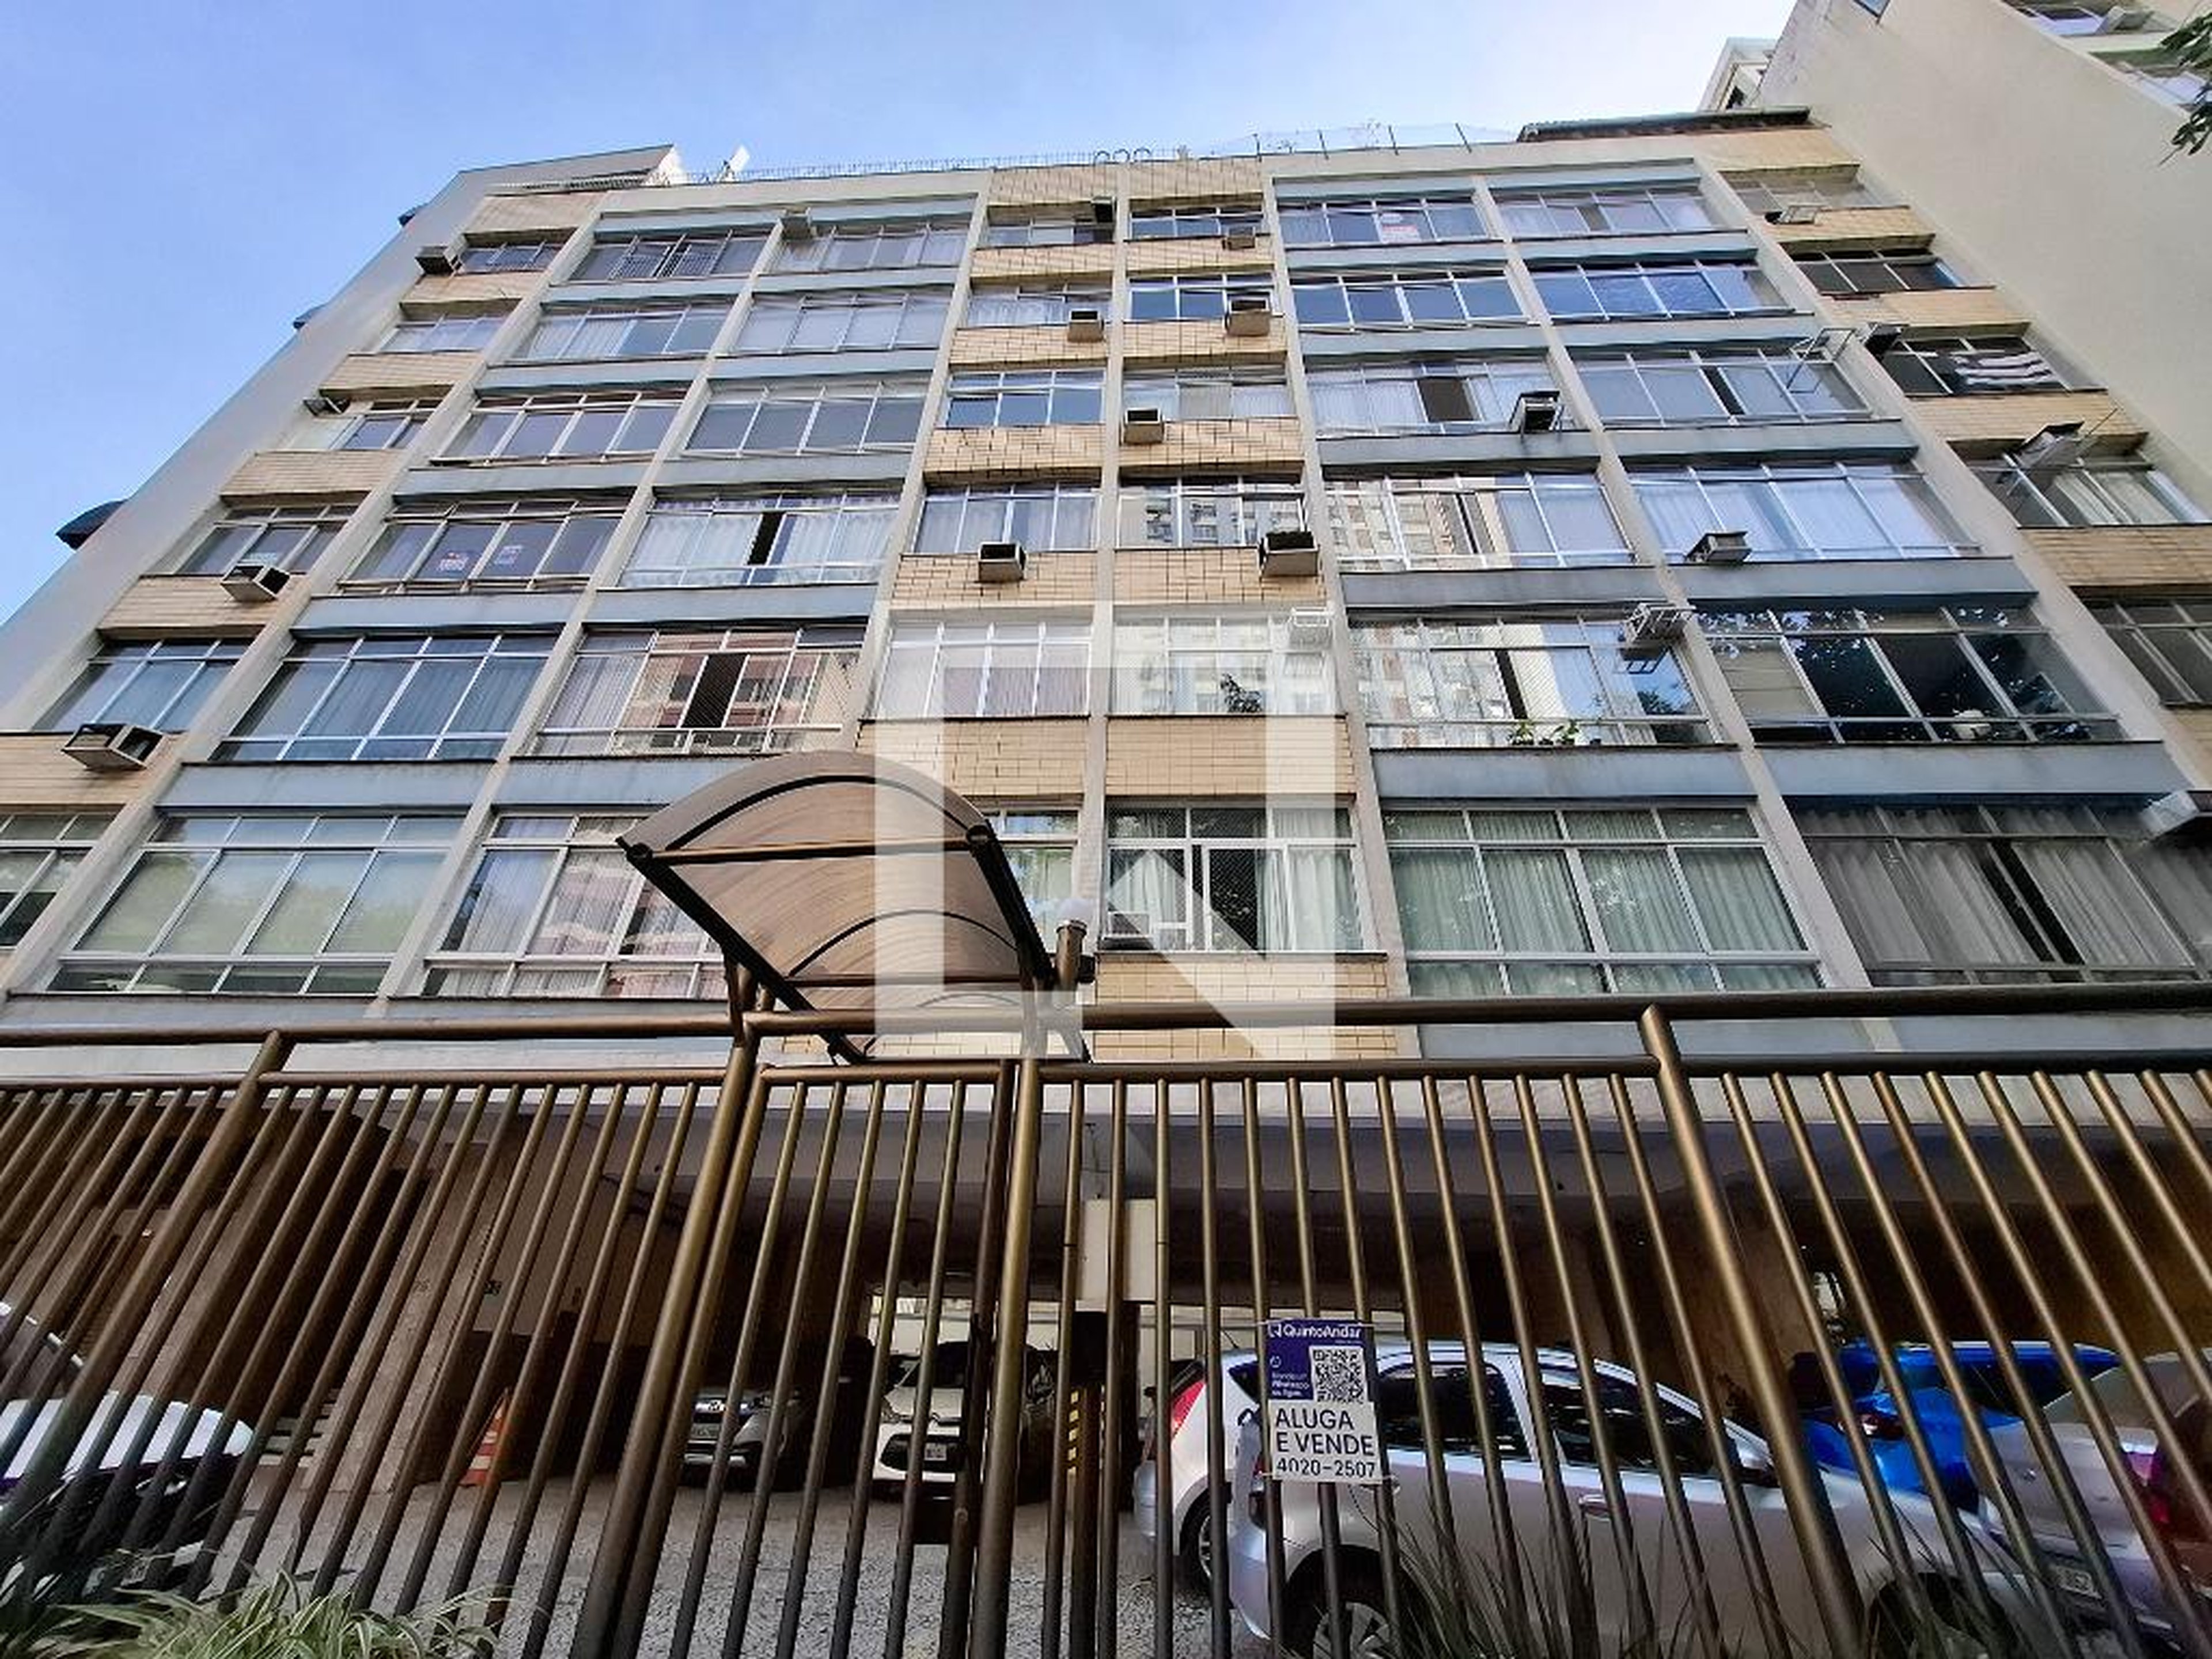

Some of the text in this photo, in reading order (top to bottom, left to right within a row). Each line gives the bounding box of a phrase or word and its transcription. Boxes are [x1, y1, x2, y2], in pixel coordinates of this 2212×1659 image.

[1283, 1324, 1361, 1338] QuintoAndar
[1276, 1408, 1354, 1430] ALUGA
[1277, 1431, 1374, 1456] E VENDE
[1277, 1457, 1376, 1478] 4020-2507
